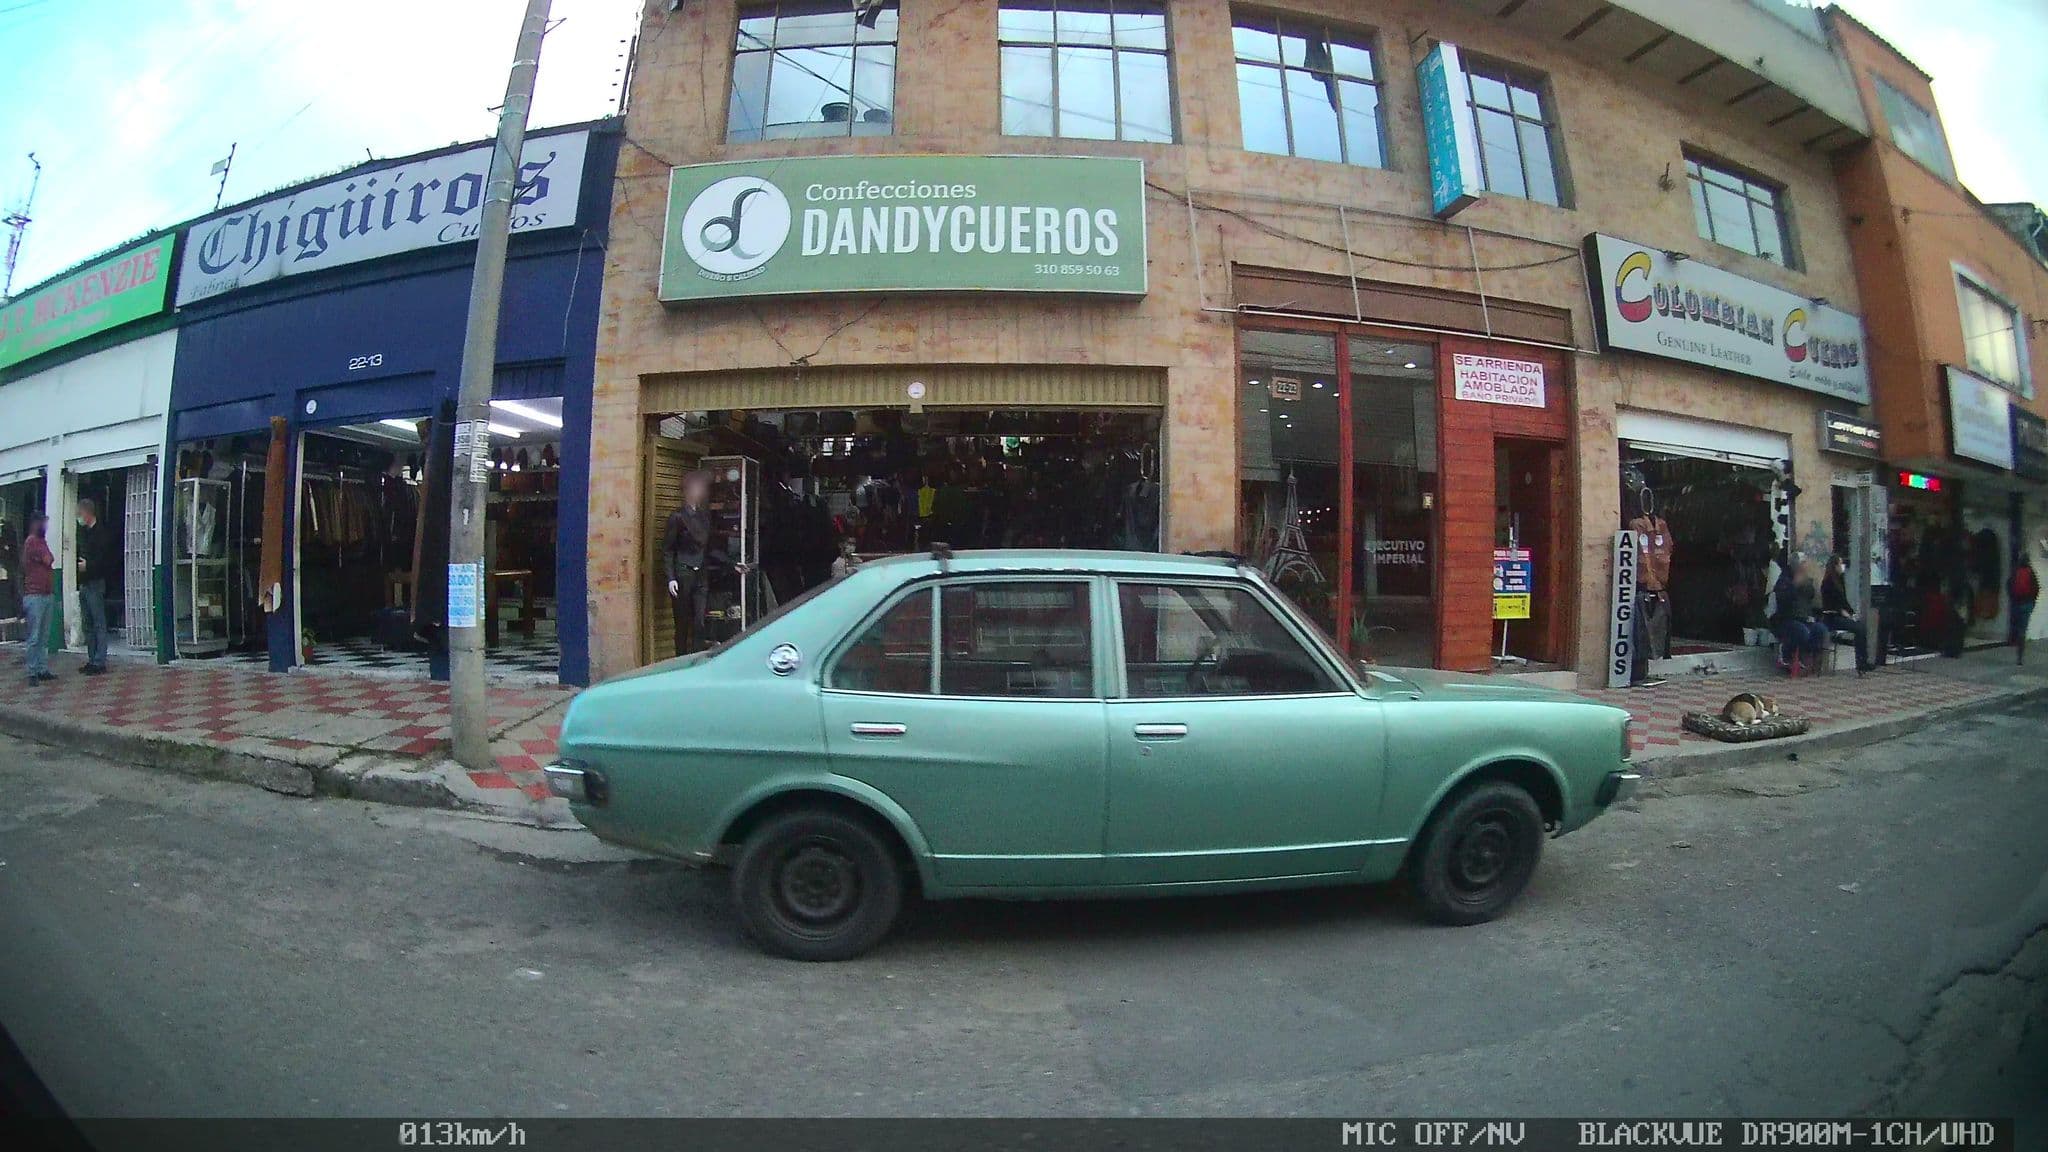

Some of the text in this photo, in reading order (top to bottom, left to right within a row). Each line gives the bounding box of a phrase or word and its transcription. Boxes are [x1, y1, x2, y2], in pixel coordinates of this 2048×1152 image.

[806, 180, 977, 202] Confecciones
[199, 151, 555, 276] Chigüiros
[437, 212, 548, 243] Cuos
[801, 205, 1119, 257] DANDYCUEROS
[1034, 264, 1120, 276] 310 859 50 63
[1615, 251, 1774, 347] COLOMBIAN
[349, 353, 383, 370] 22-13
[1455, 355, 1542, 375] SE ARRIENDA
[1460, 370, 1538, 387] HABITACION
[1463, 380, 1537, 396] AMOBLADA
[1372, 553, 1425, 565] IMPERIAL
[1614, 531, 1634, 676] ARREGLOS
